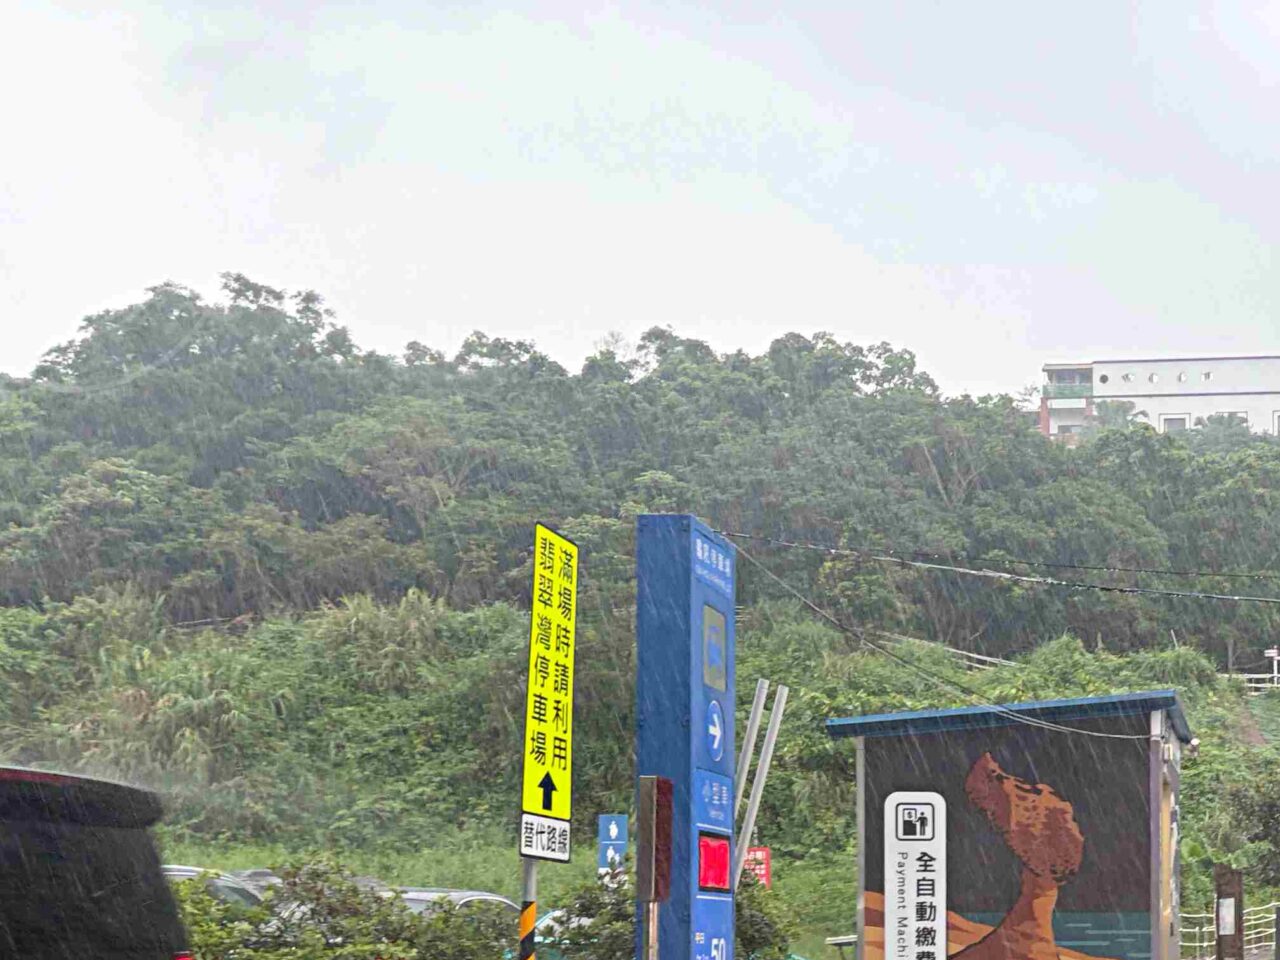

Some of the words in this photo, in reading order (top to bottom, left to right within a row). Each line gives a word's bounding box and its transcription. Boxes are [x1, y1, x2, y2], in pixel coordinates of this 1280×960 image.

[530, 536, 556, 767] 翡翠灣停車場
[551, 546, 574, 771] 滿場時請利用
[523, 821, 570, 855] 替代路線
[897, 852, 908, 910] Payment
